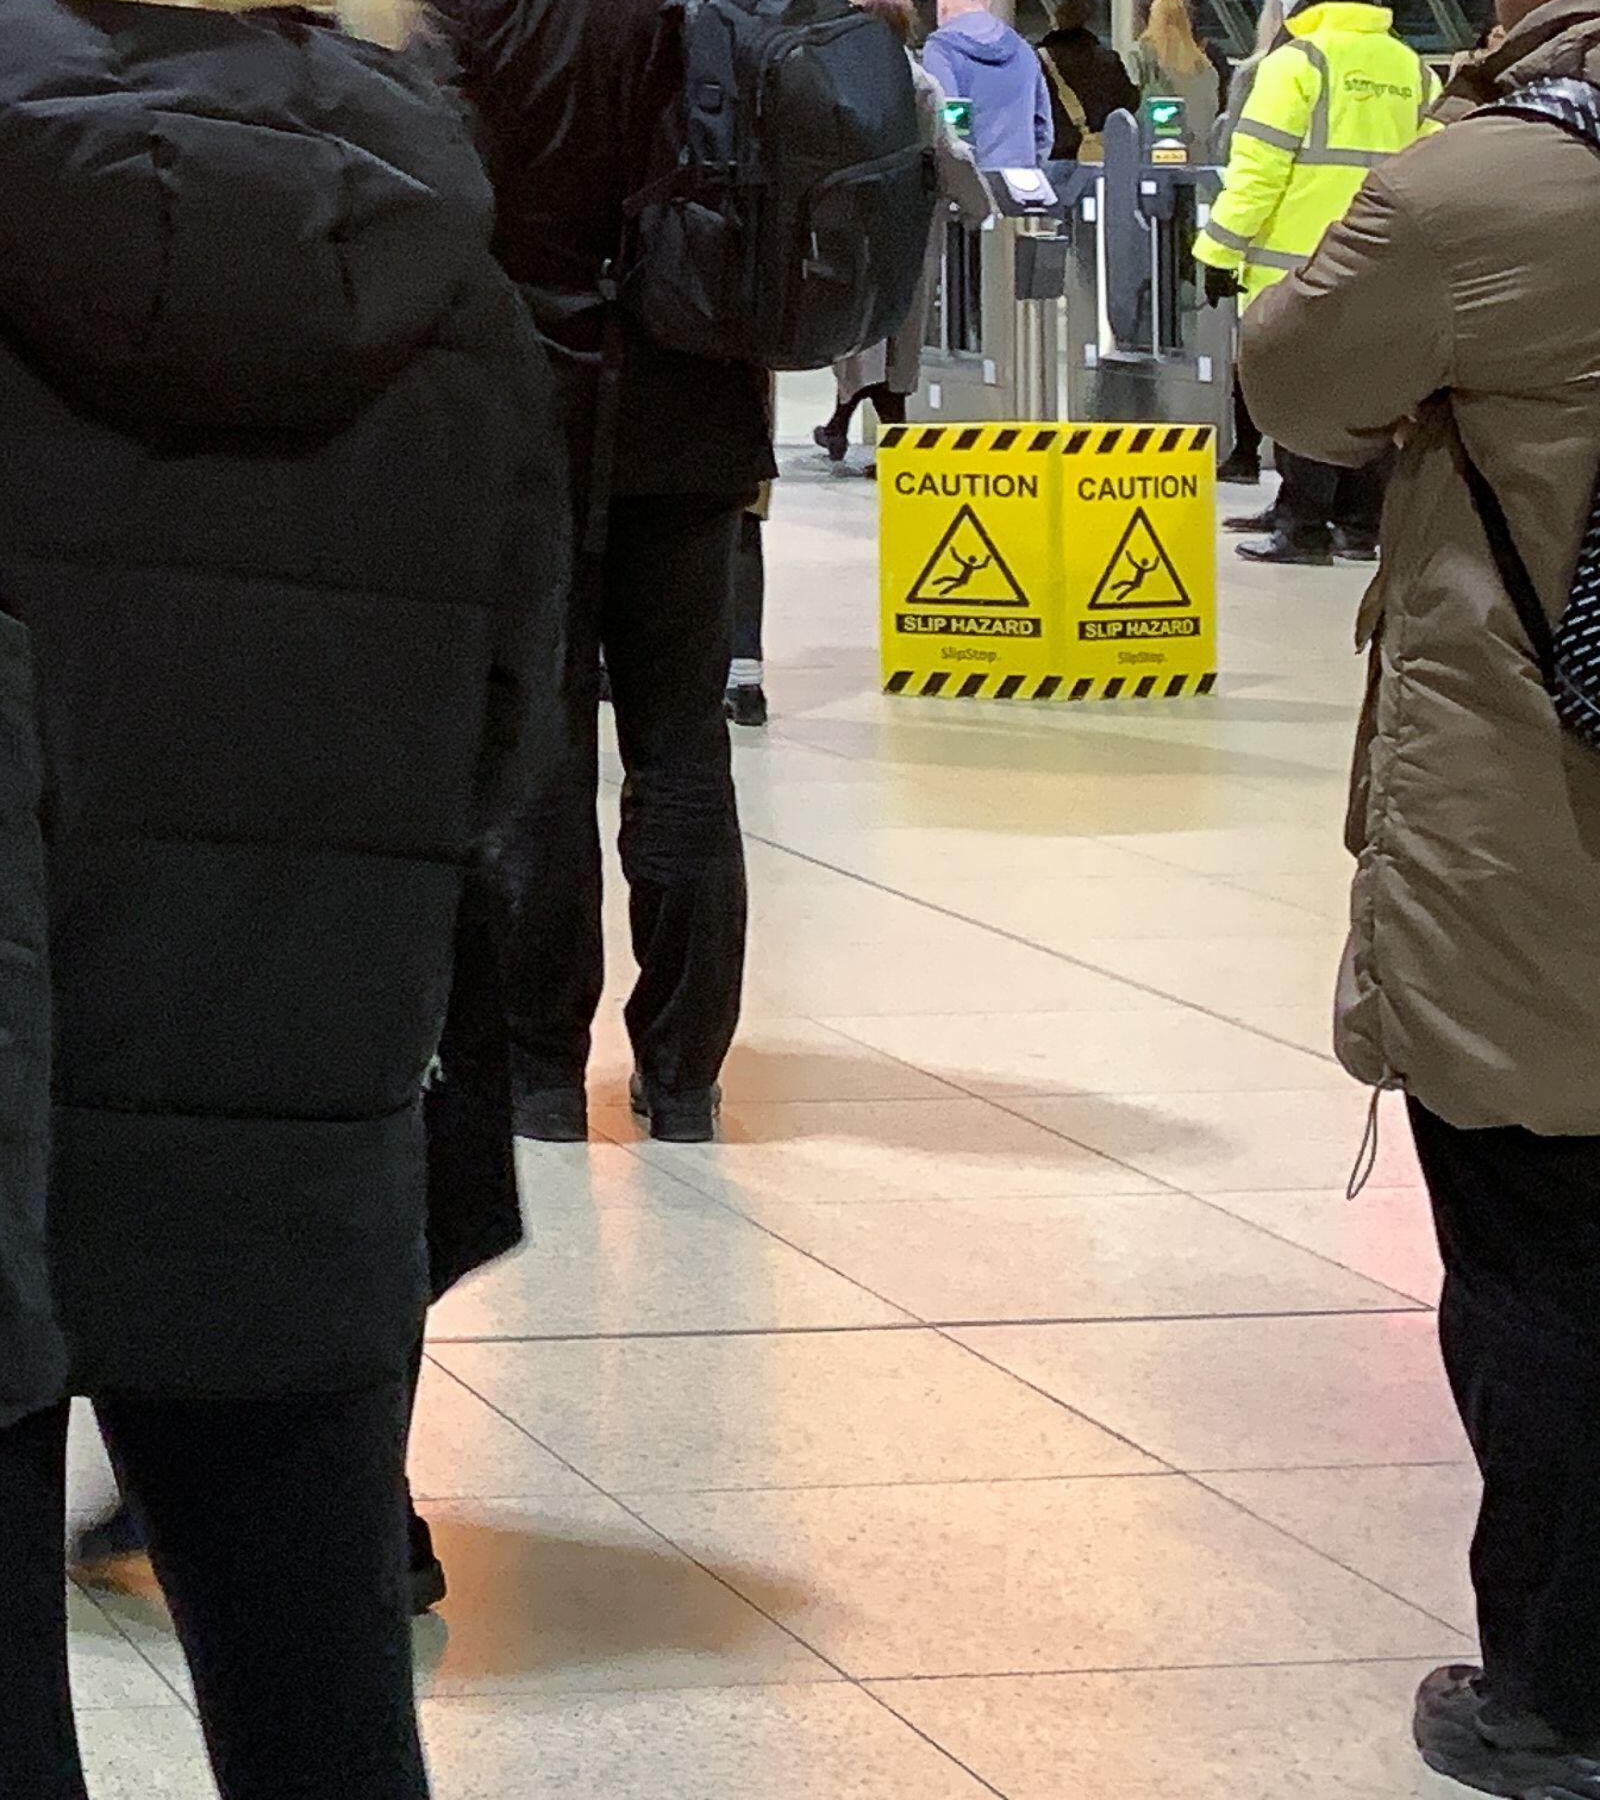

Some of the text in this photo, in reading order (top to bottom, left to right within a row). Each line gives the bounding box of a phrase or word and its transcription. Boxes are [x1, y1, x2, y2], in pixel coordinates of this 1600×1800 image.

[895, 471, 1039, 498] CAUTION
[1077, 474, 1198, 501] CAUTION
[903, 616, 1034, 635] SLIP HAZARD
[1085, 619, 1195, 638] SLIP HAZARD
